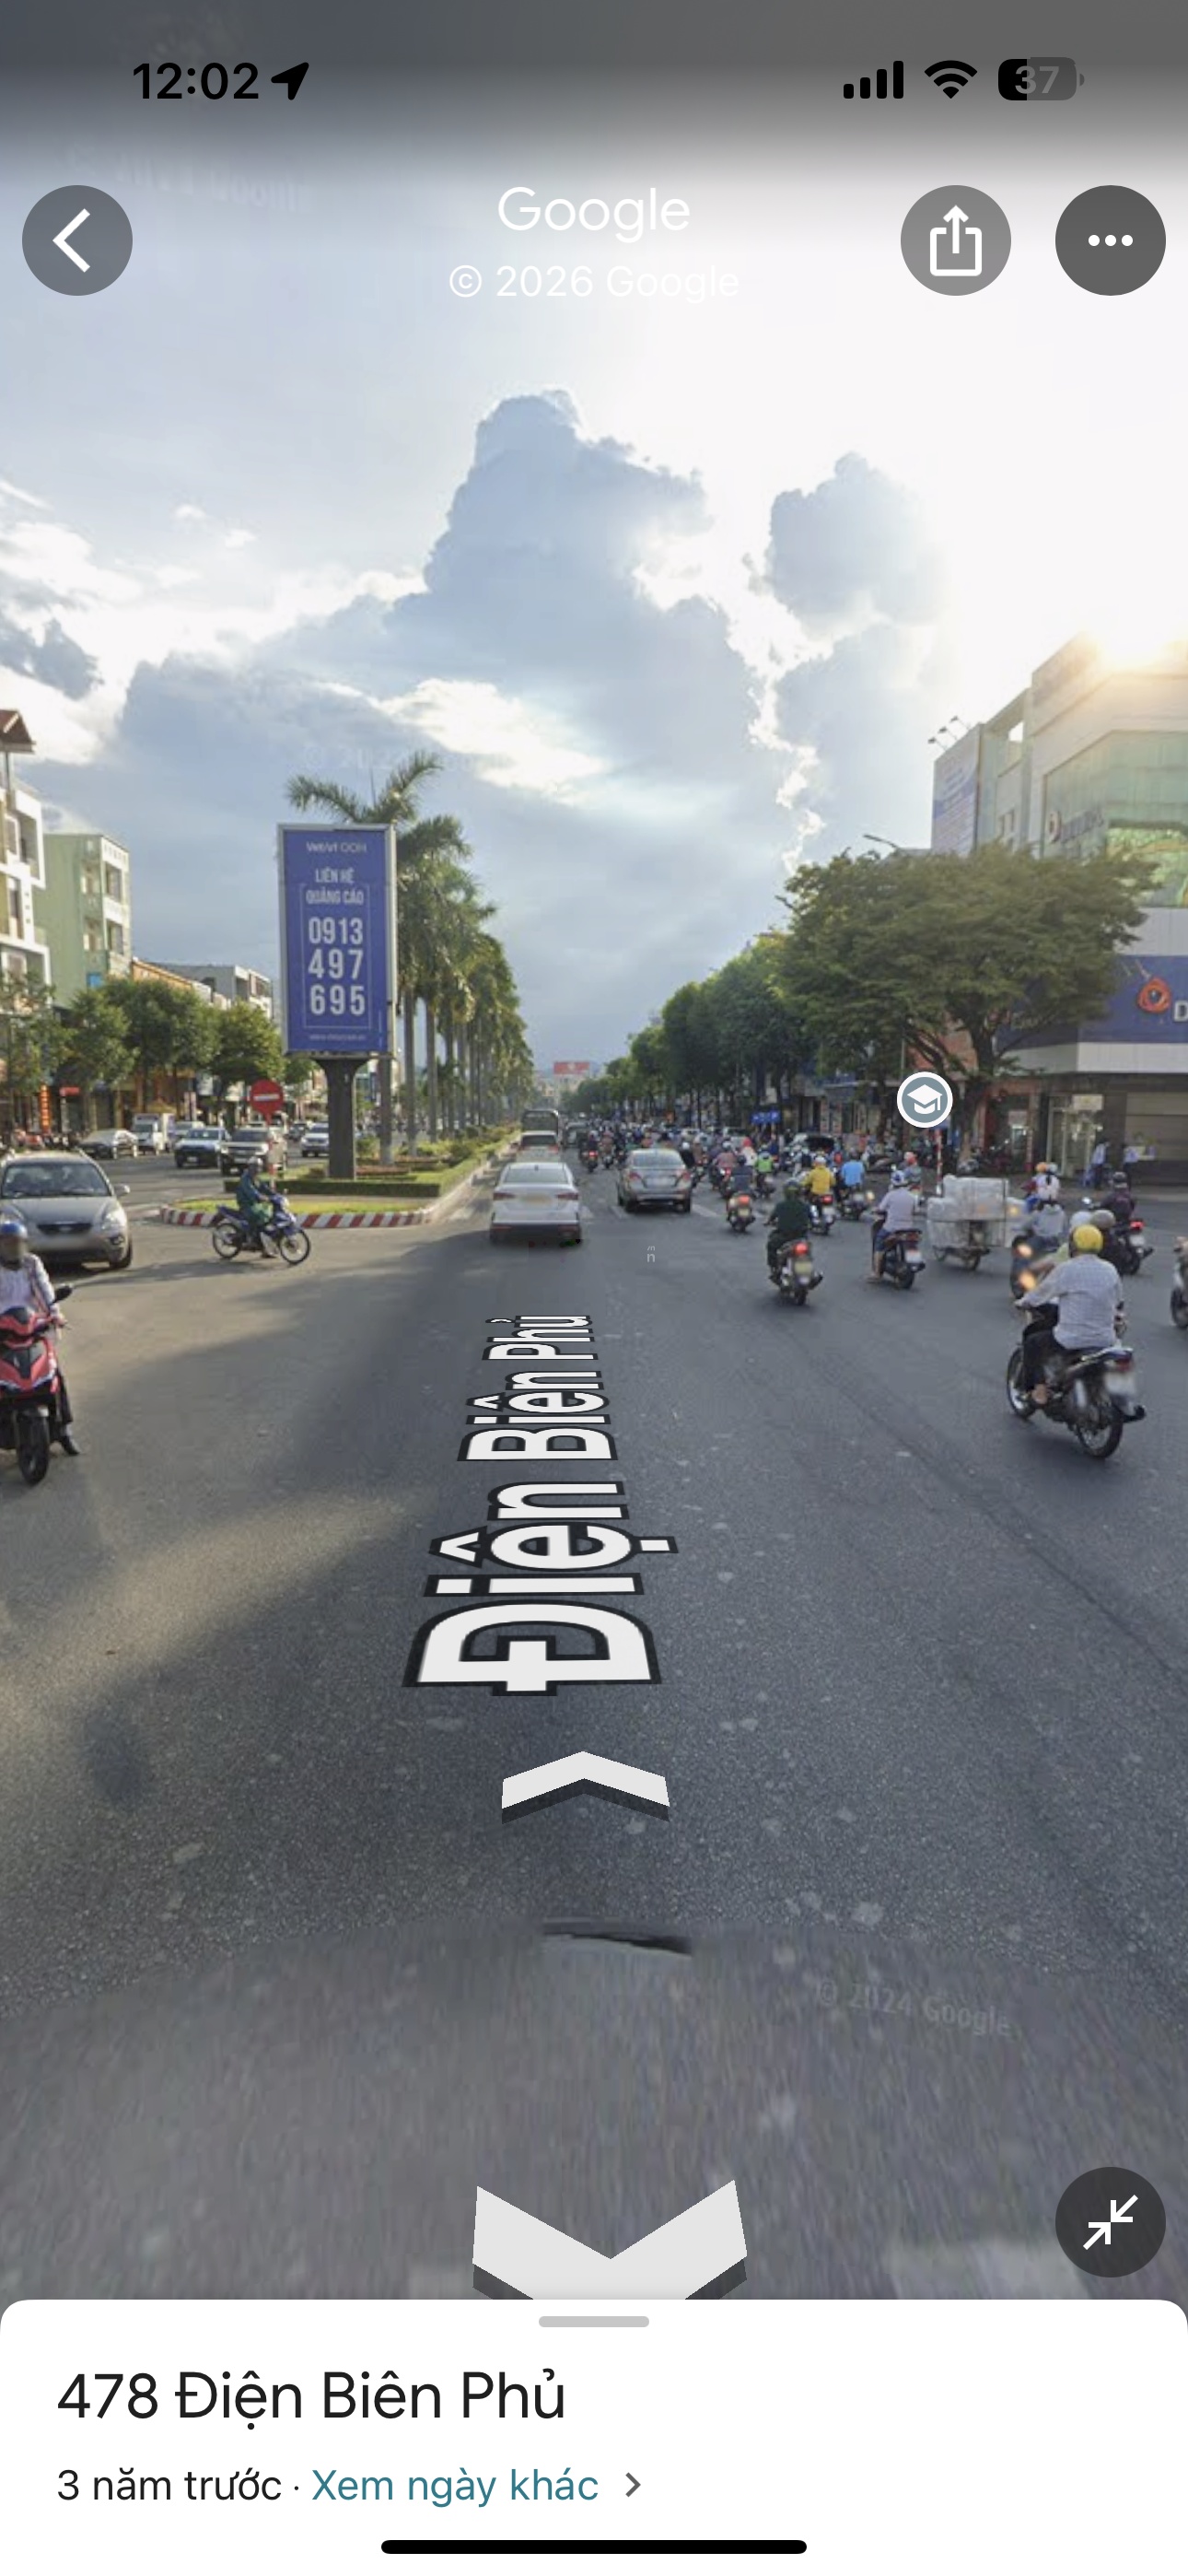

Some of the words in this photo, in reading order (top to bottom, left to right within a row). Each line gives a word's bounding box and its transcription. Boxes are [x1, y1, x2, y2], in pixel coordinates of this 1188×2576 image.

[308, 916, 364, 944] 0913
[308, 948, 364, 979] 497
[309, 983, 366, 1016] 695
